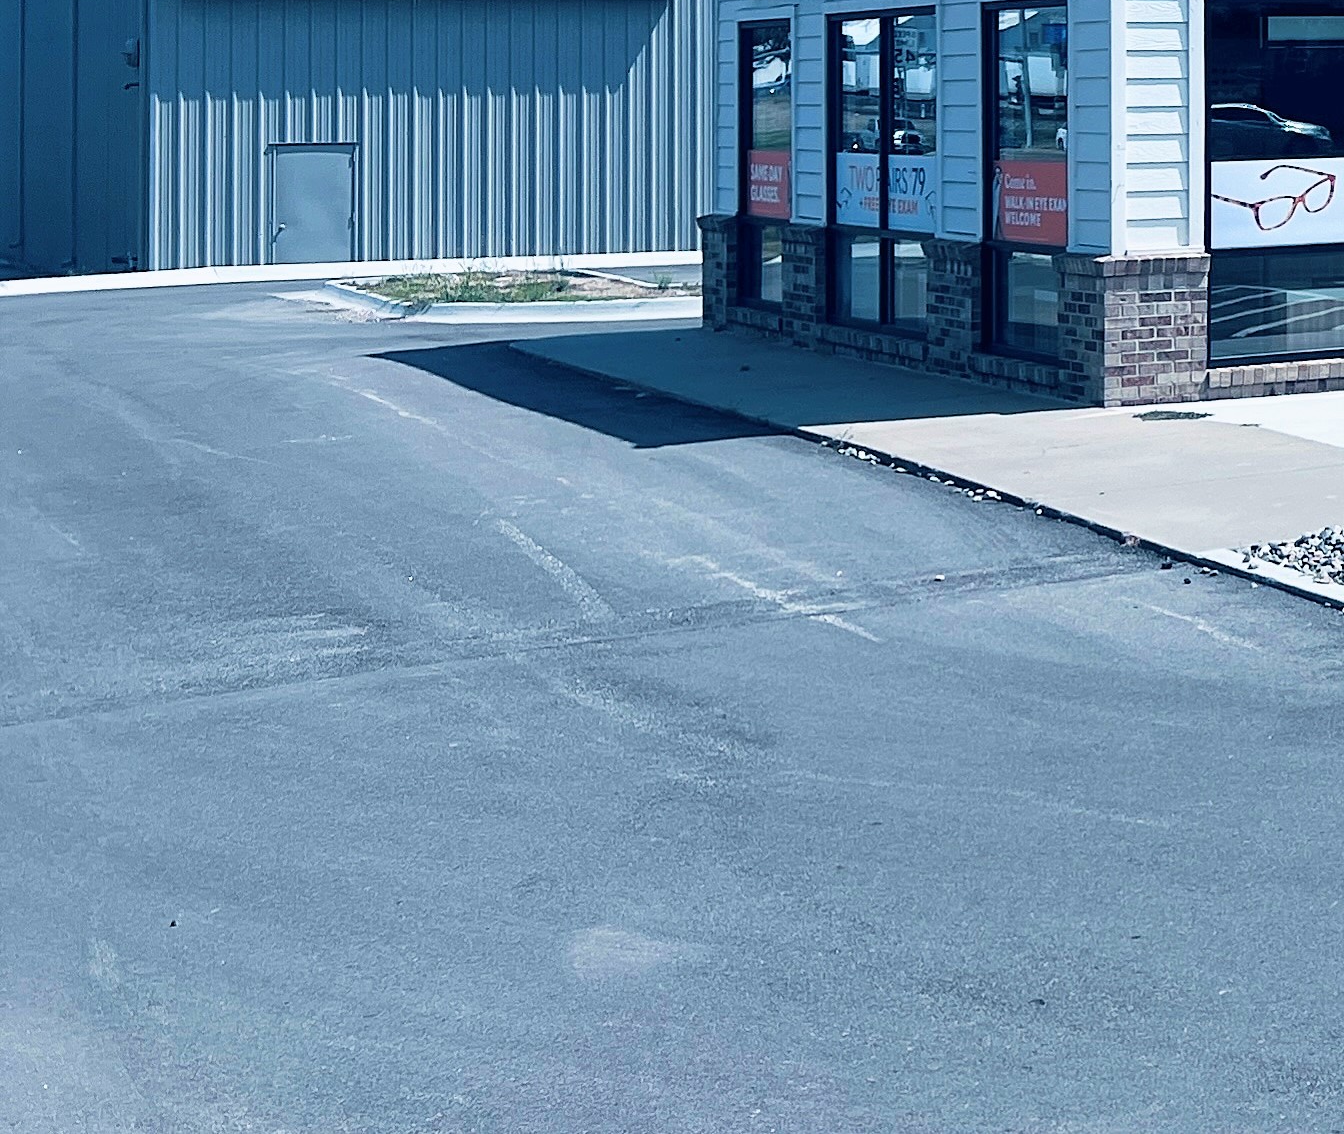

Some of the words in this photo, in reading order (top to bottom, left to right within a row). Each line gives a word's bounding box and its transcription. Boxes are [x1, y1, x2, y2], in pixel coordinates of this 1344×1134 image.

[848, 165, 874, 192] TWO
[1034, 196, 1048, 212] EYE
[1004, 211, 1042, 227] WELCOME
